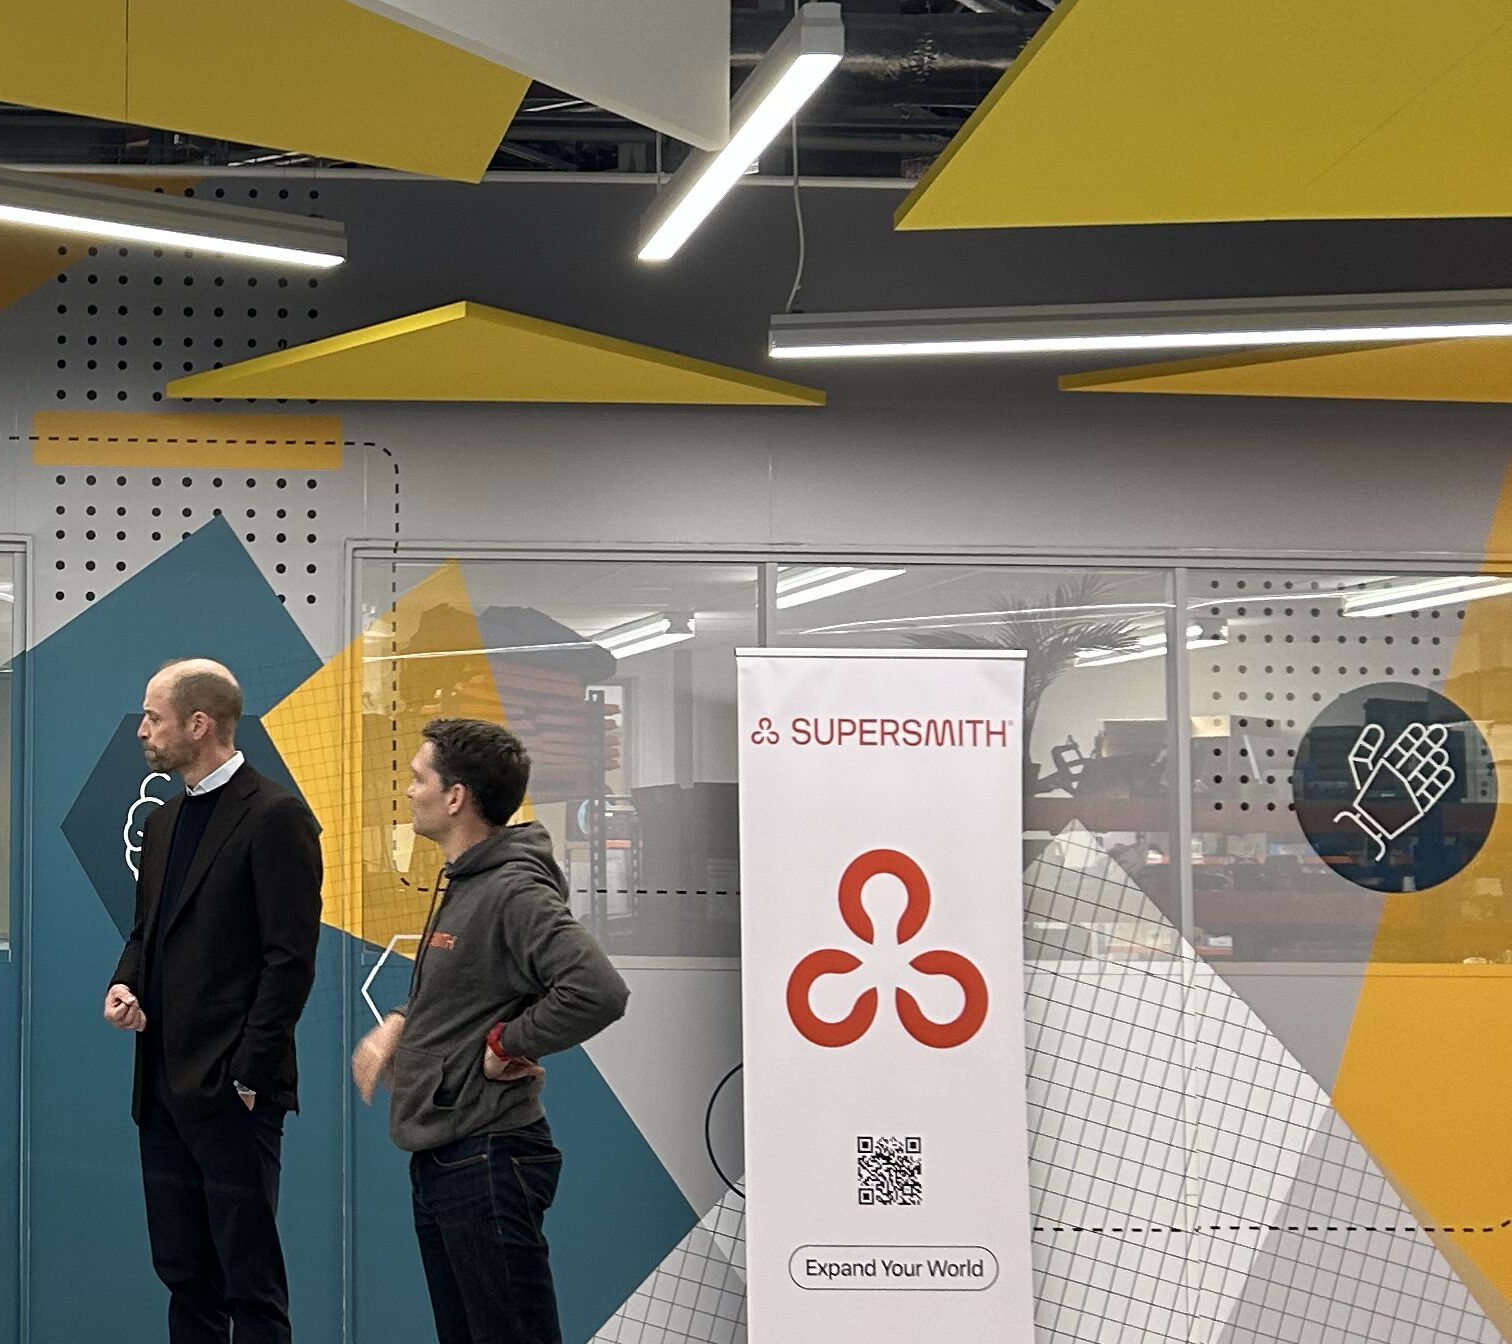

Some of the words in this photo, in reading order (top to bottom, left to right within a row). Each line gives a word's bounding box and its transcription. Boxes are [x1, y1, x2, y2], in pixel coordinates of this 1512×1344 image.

[791, 717, 1008, 748] SUPERSMITH
[806, 1258, 877, 1281] Expand
[880, 1259, 924, 1278] Your
[926, 1259, 985, 1278] World
